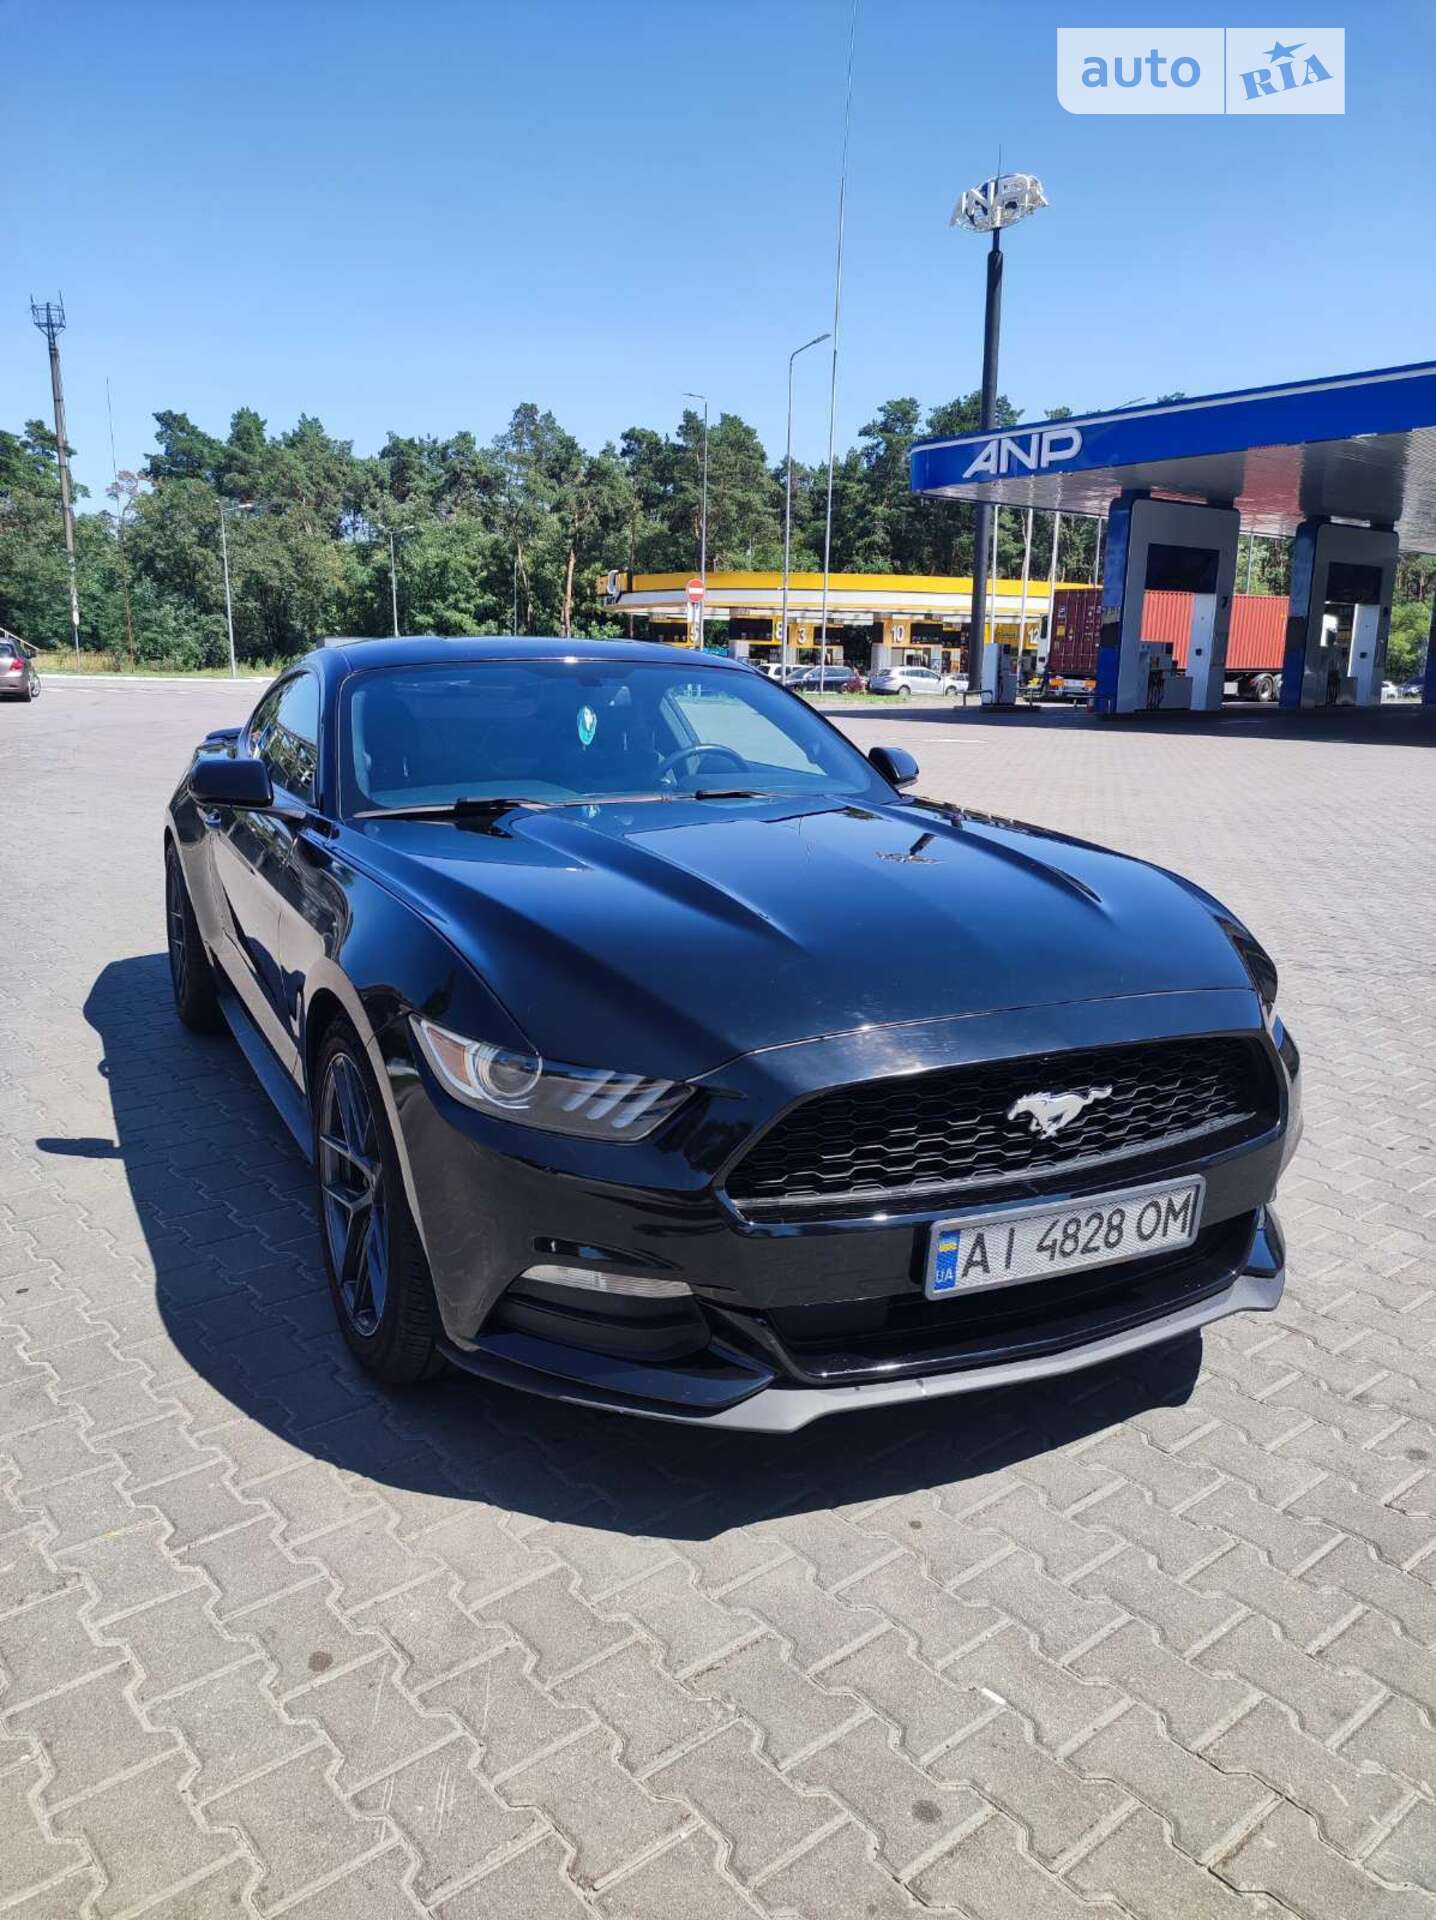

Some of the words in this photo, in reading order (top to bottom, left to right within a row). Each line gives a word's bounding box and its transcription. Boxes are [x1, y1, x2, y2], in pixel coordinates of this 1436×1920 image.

[961, 428, 1083, 479] ANP
[891, 624, 904, 642] 10
[962, 1227, 1016, 1279] AI
[1035, 1207, 1126, 1262] 4828
[1136, 1191, 1193, 1242] OM
[936, 1269, 954, 1282] UA
